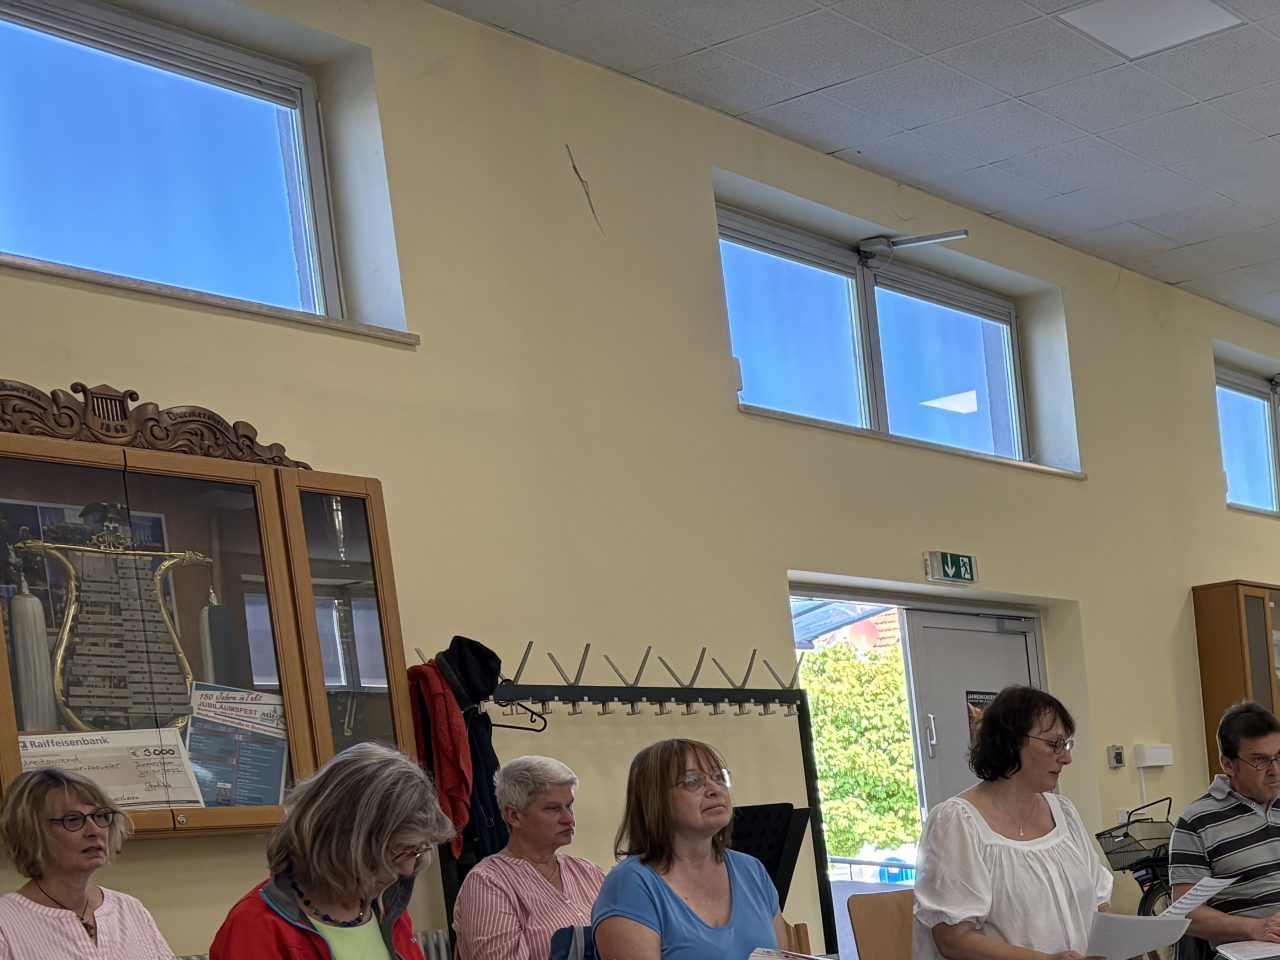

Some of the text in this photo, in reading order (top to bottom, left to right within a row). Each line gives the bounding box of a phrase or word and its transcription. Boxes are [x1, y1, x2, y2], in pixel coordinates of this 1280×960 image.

[100, 422, 128, 434] 1868
[200, 693, 214, 701] 150
[29, 736, 109, 749] Raiffeisenbank
[144, 749, 175, 757] 3000
